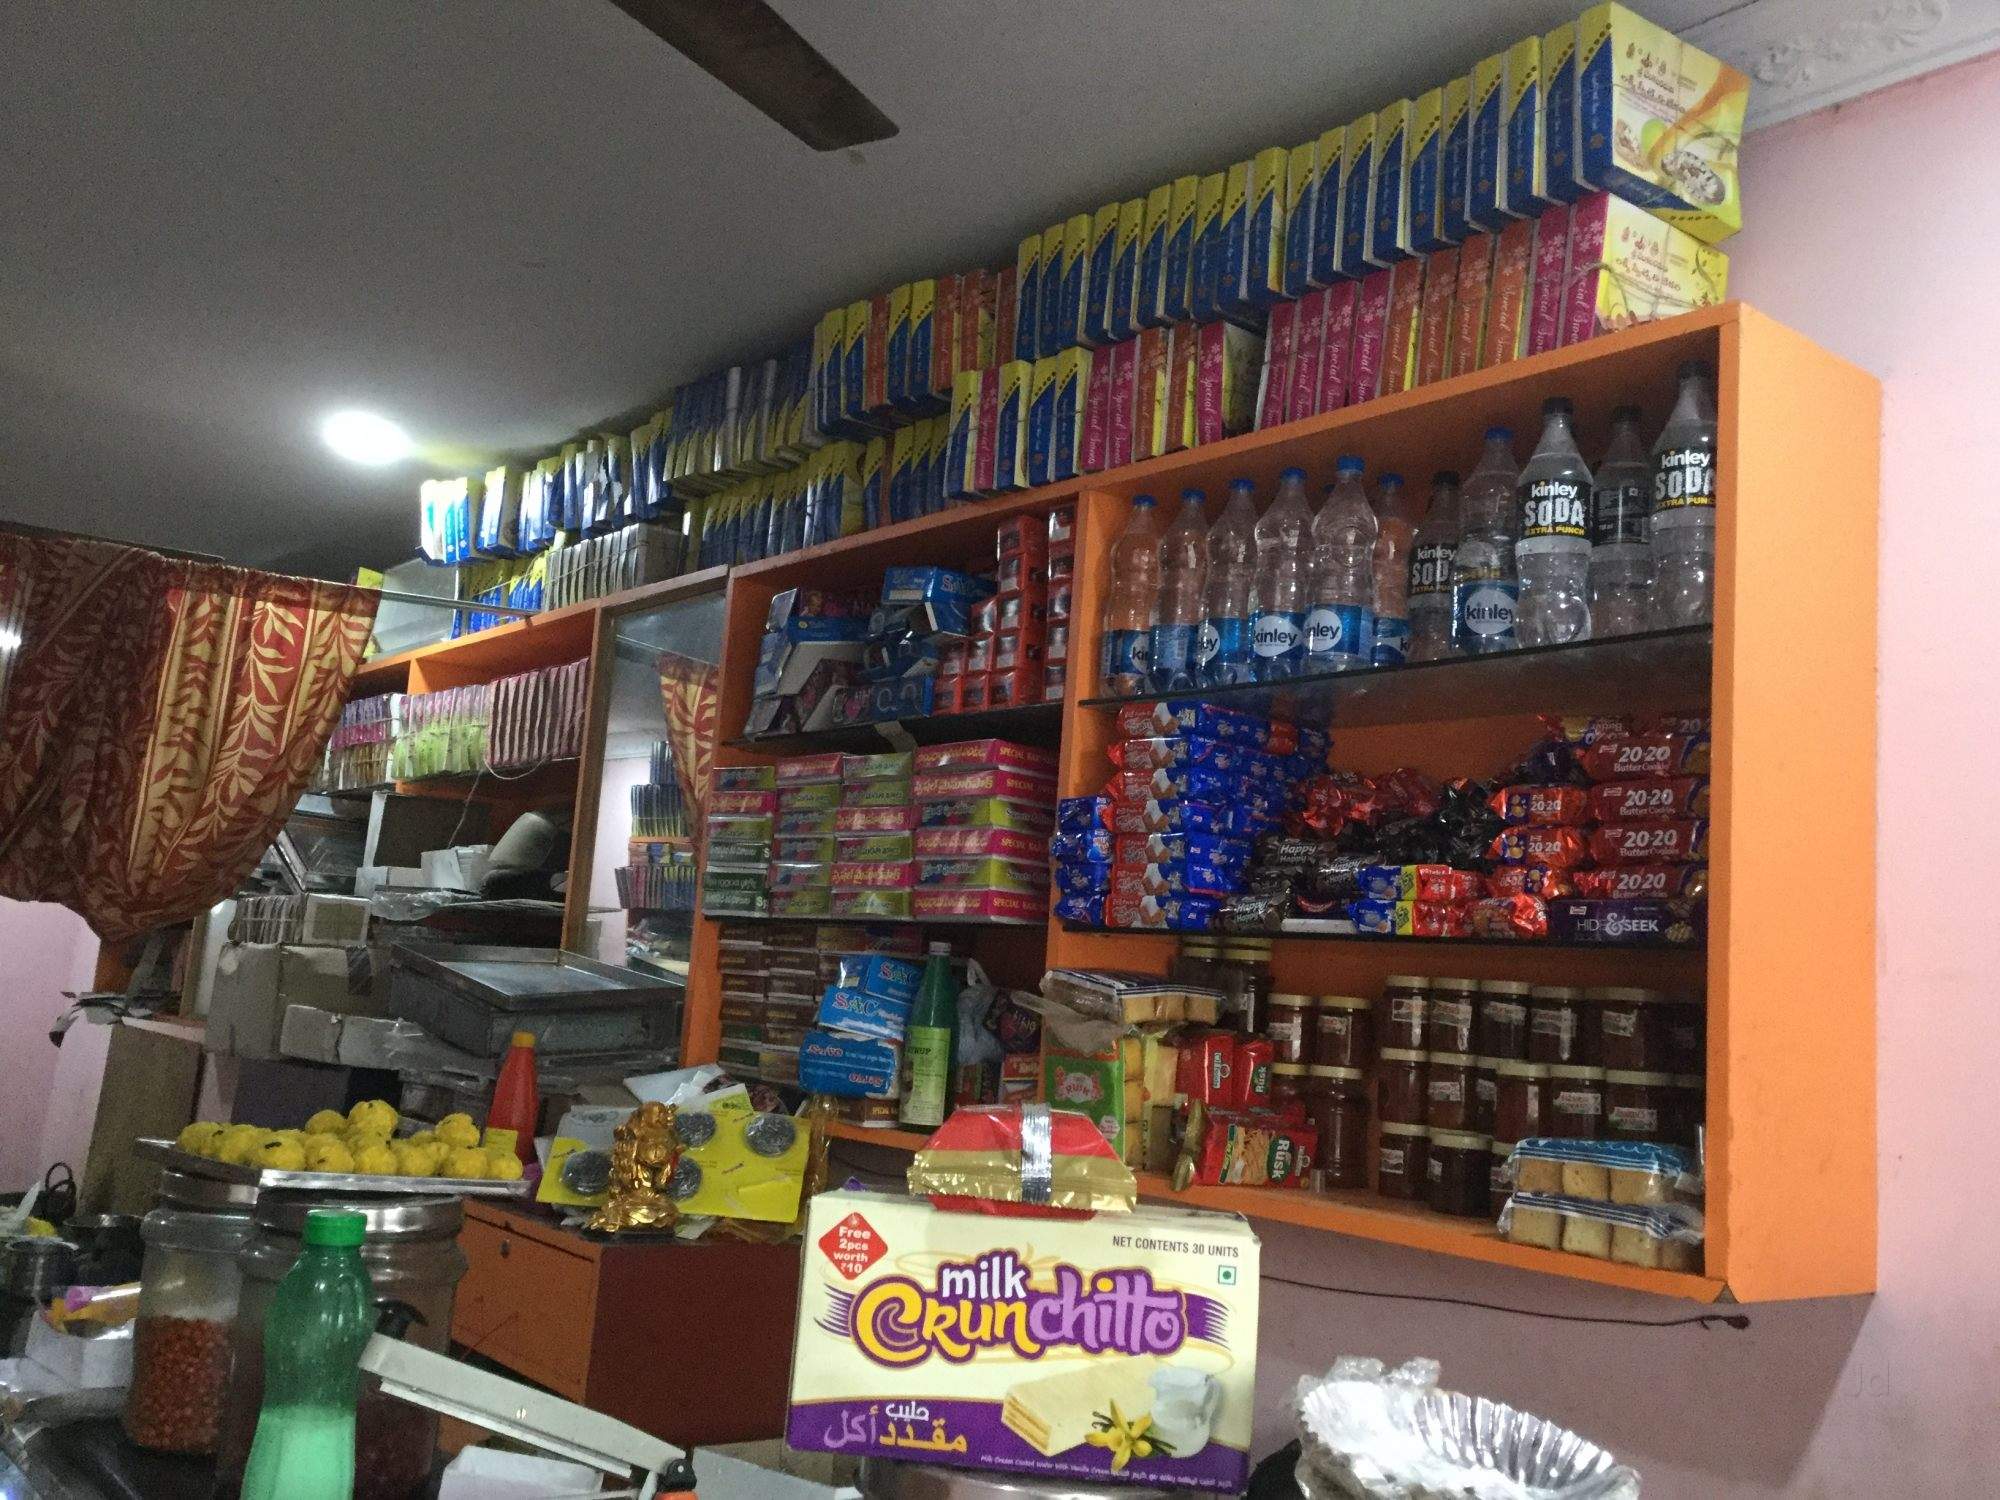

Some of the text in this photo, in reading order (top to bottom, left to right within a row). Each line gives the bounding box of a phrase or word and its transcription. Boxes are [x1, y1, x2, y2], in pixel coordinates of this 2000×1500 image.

[1661, 450, 1711, 469] kinley
[1531, 481, 1578, 498] kinley
[1524, 497, 1585, 526] SODA
[1555, 525, 1585, 536] PUNCH
[1417, 546, 1456, 560] kinley
[1412, 560, 1449, 585] SOD
[1254, 628, 1298, 646] kinley
[1280, 843, 1317, 856] Happy
[1624, 919, 1659, 932] SEEK
[839, 1226, 871, 1239] Free
[839, 1238, 868, 1251] 2pcs
[1113, 1235, 1239, 1257] NET CONTENTS 30 UNITS
[834, 1252, 868, 1262] worth
[942, 1256, 1027, 1299] milk
[885, 1401, 929, 1422] حليب
